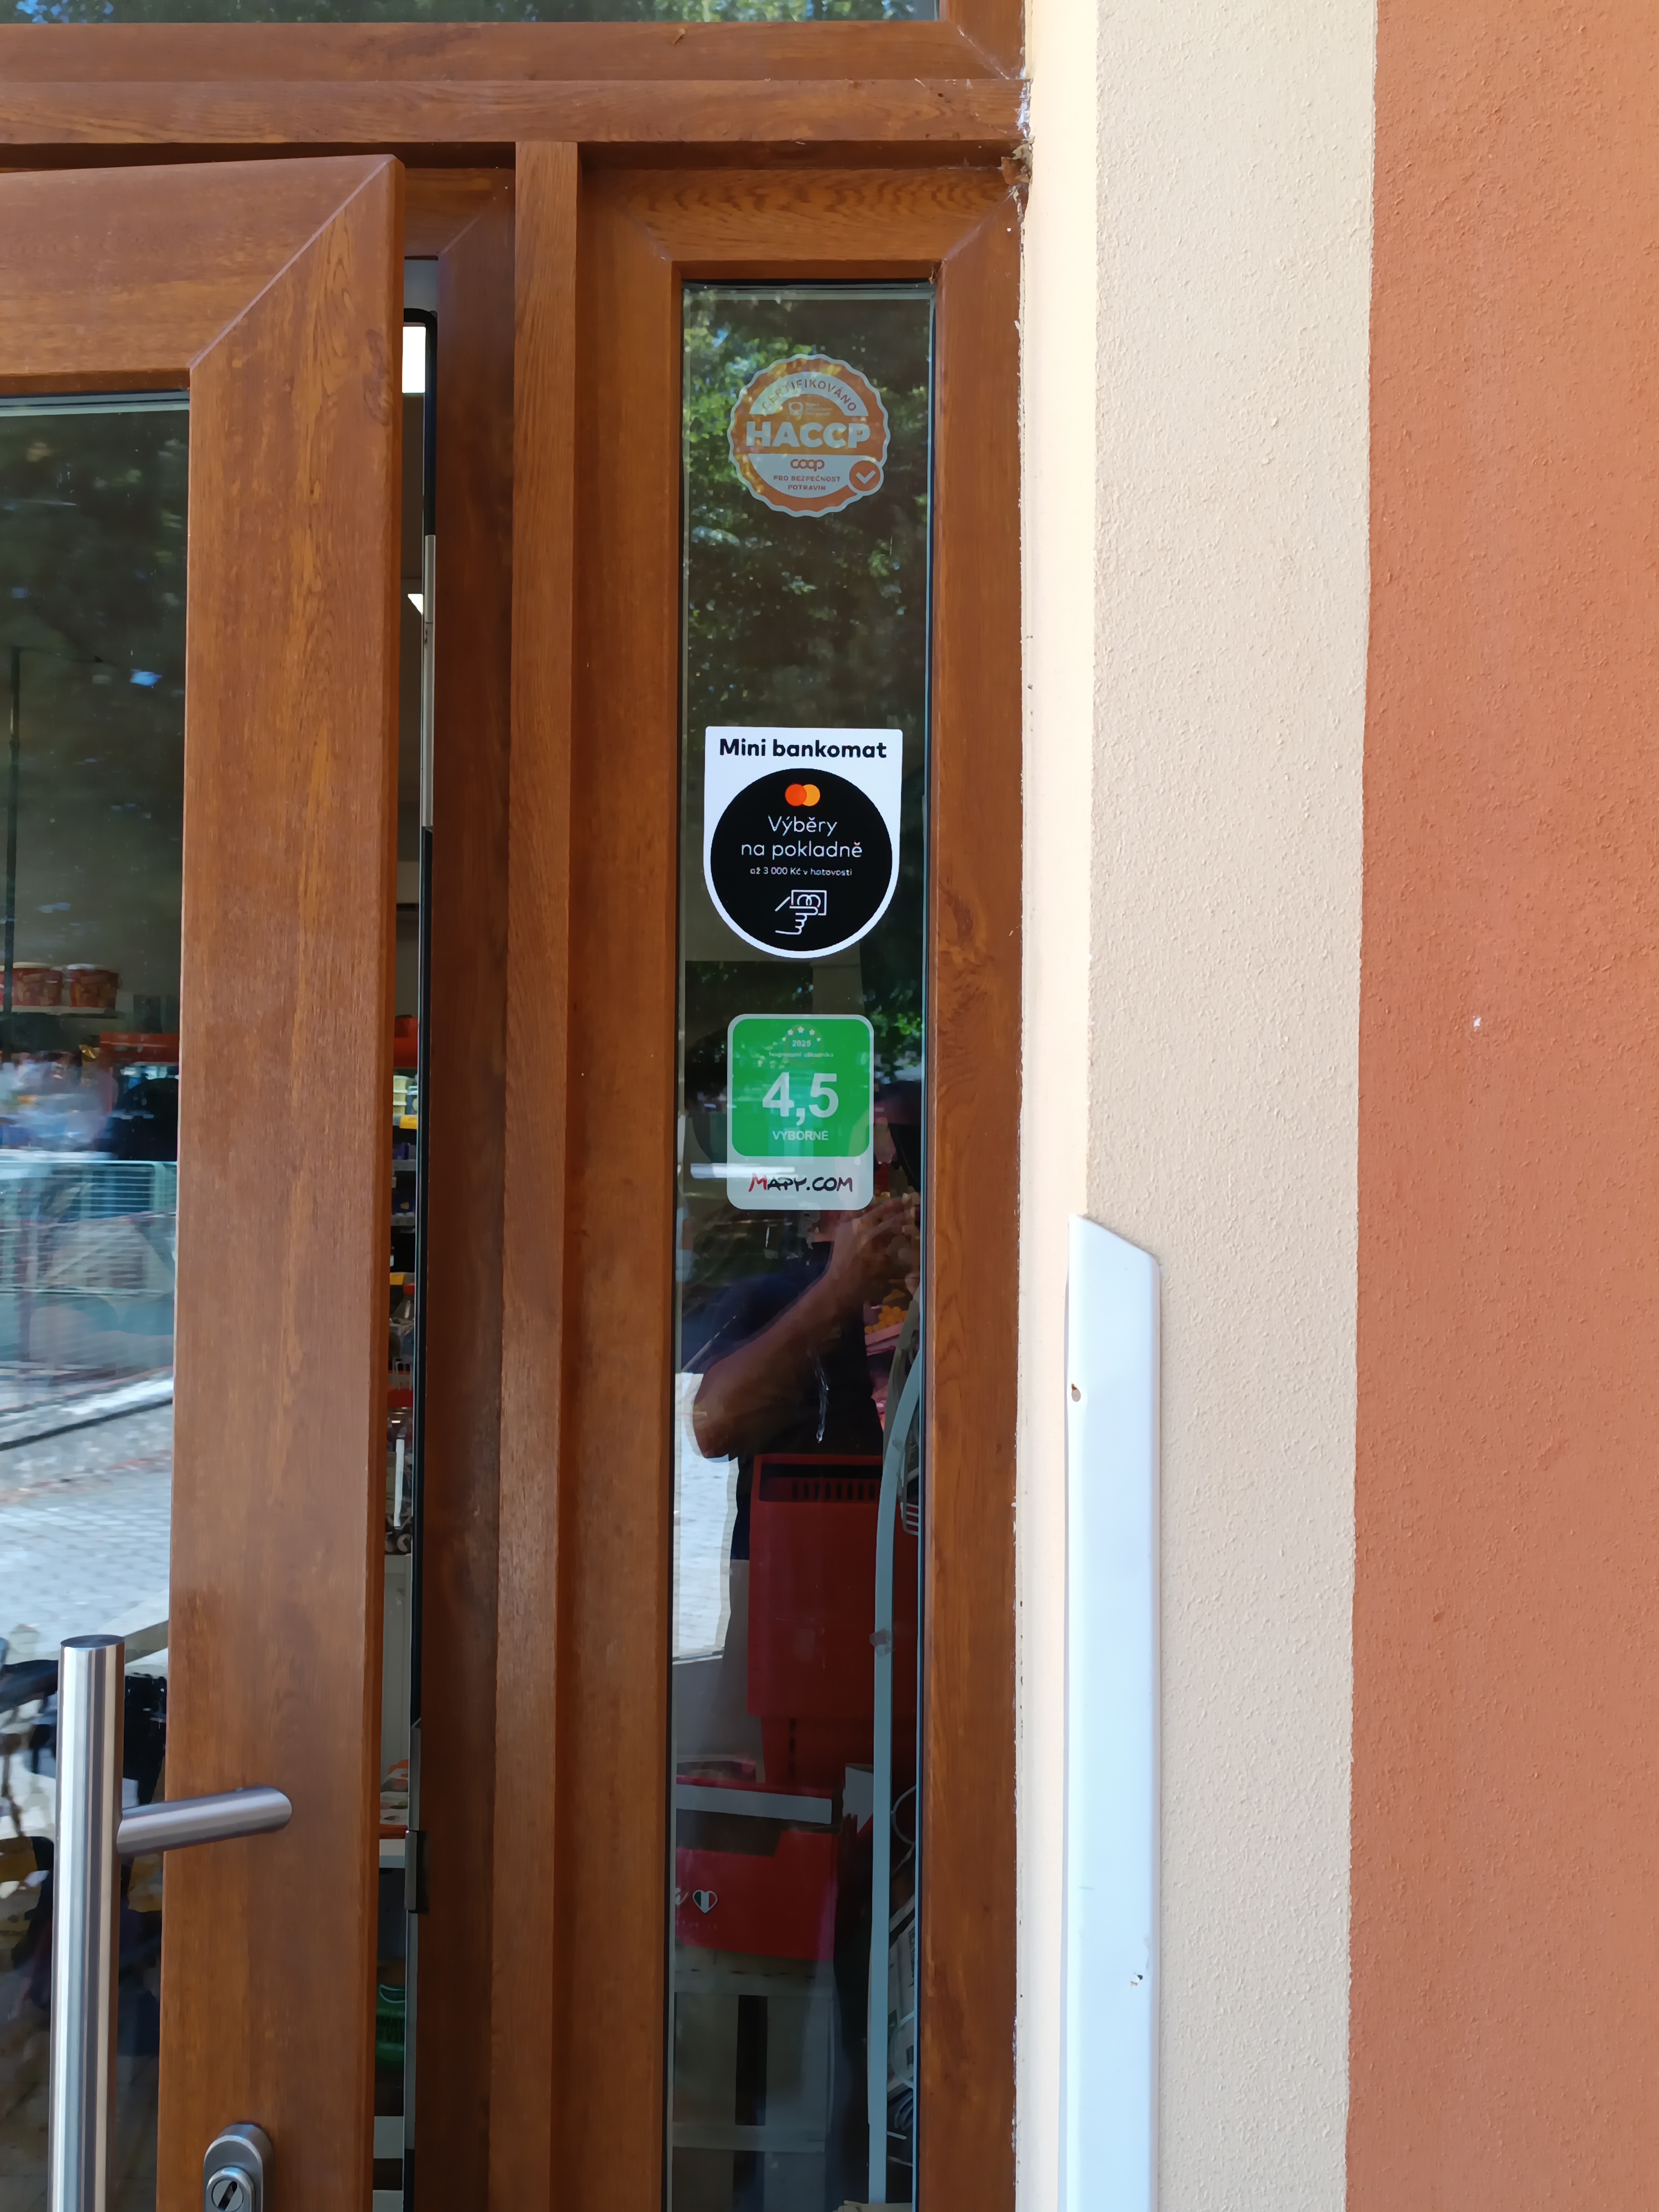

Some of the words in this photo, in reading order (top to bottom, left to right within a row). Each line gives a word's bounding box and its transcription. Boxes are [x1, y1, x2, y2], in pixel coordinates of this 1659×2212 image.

[761, 379, 857, 411] CERTIFIKOVÁNO
[746, 421, 870, 448] HACCP
[719, 738, 766, 757] Mini
[773, 739, 887, 758] bankomat
[768, 815, 838, 836] Výběry
[741, 844, 765, 856] na
[772, 840, 863, 860] pokladně
[770, 867, 787, 875] 000
[790, 867, 801, 875] Kč
[810, 868, 852, 876] hotovosti
[763, 1072, 838, 1126] 4,5
